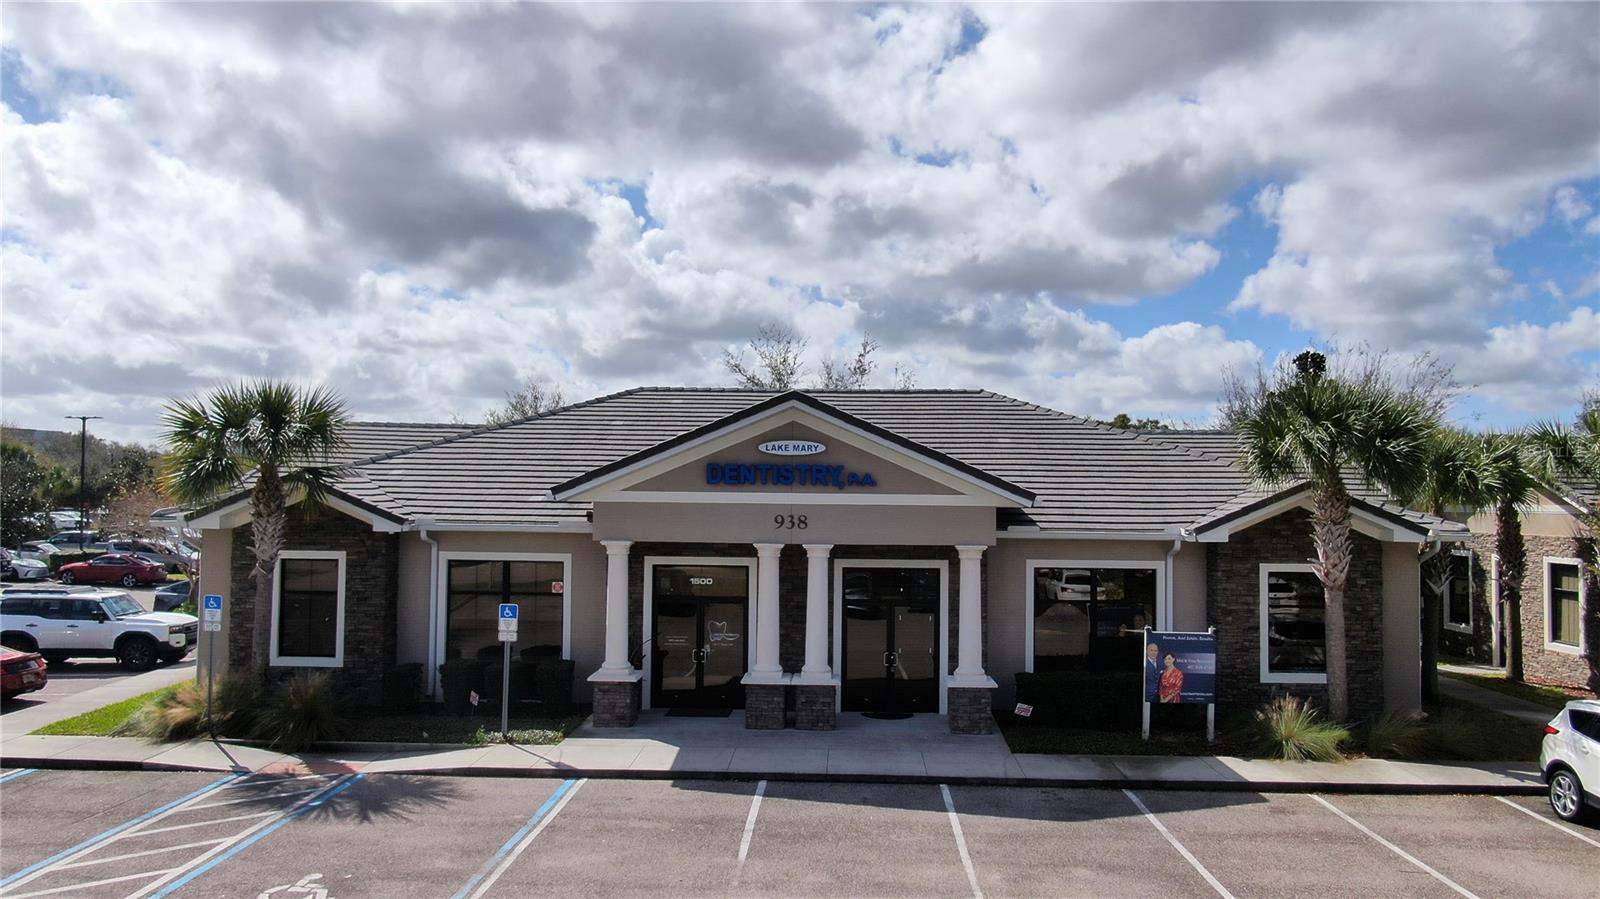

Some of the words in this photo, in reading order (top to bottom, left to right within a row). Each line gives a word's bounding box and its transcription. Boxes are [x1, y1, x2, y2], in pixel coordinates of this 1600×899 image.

[765, 444, 790, 452] LAKE
[792, 444, 819, 452] MARY
[774, 514, 808, 530] 938
[689, 577, 713, 585] 1500
